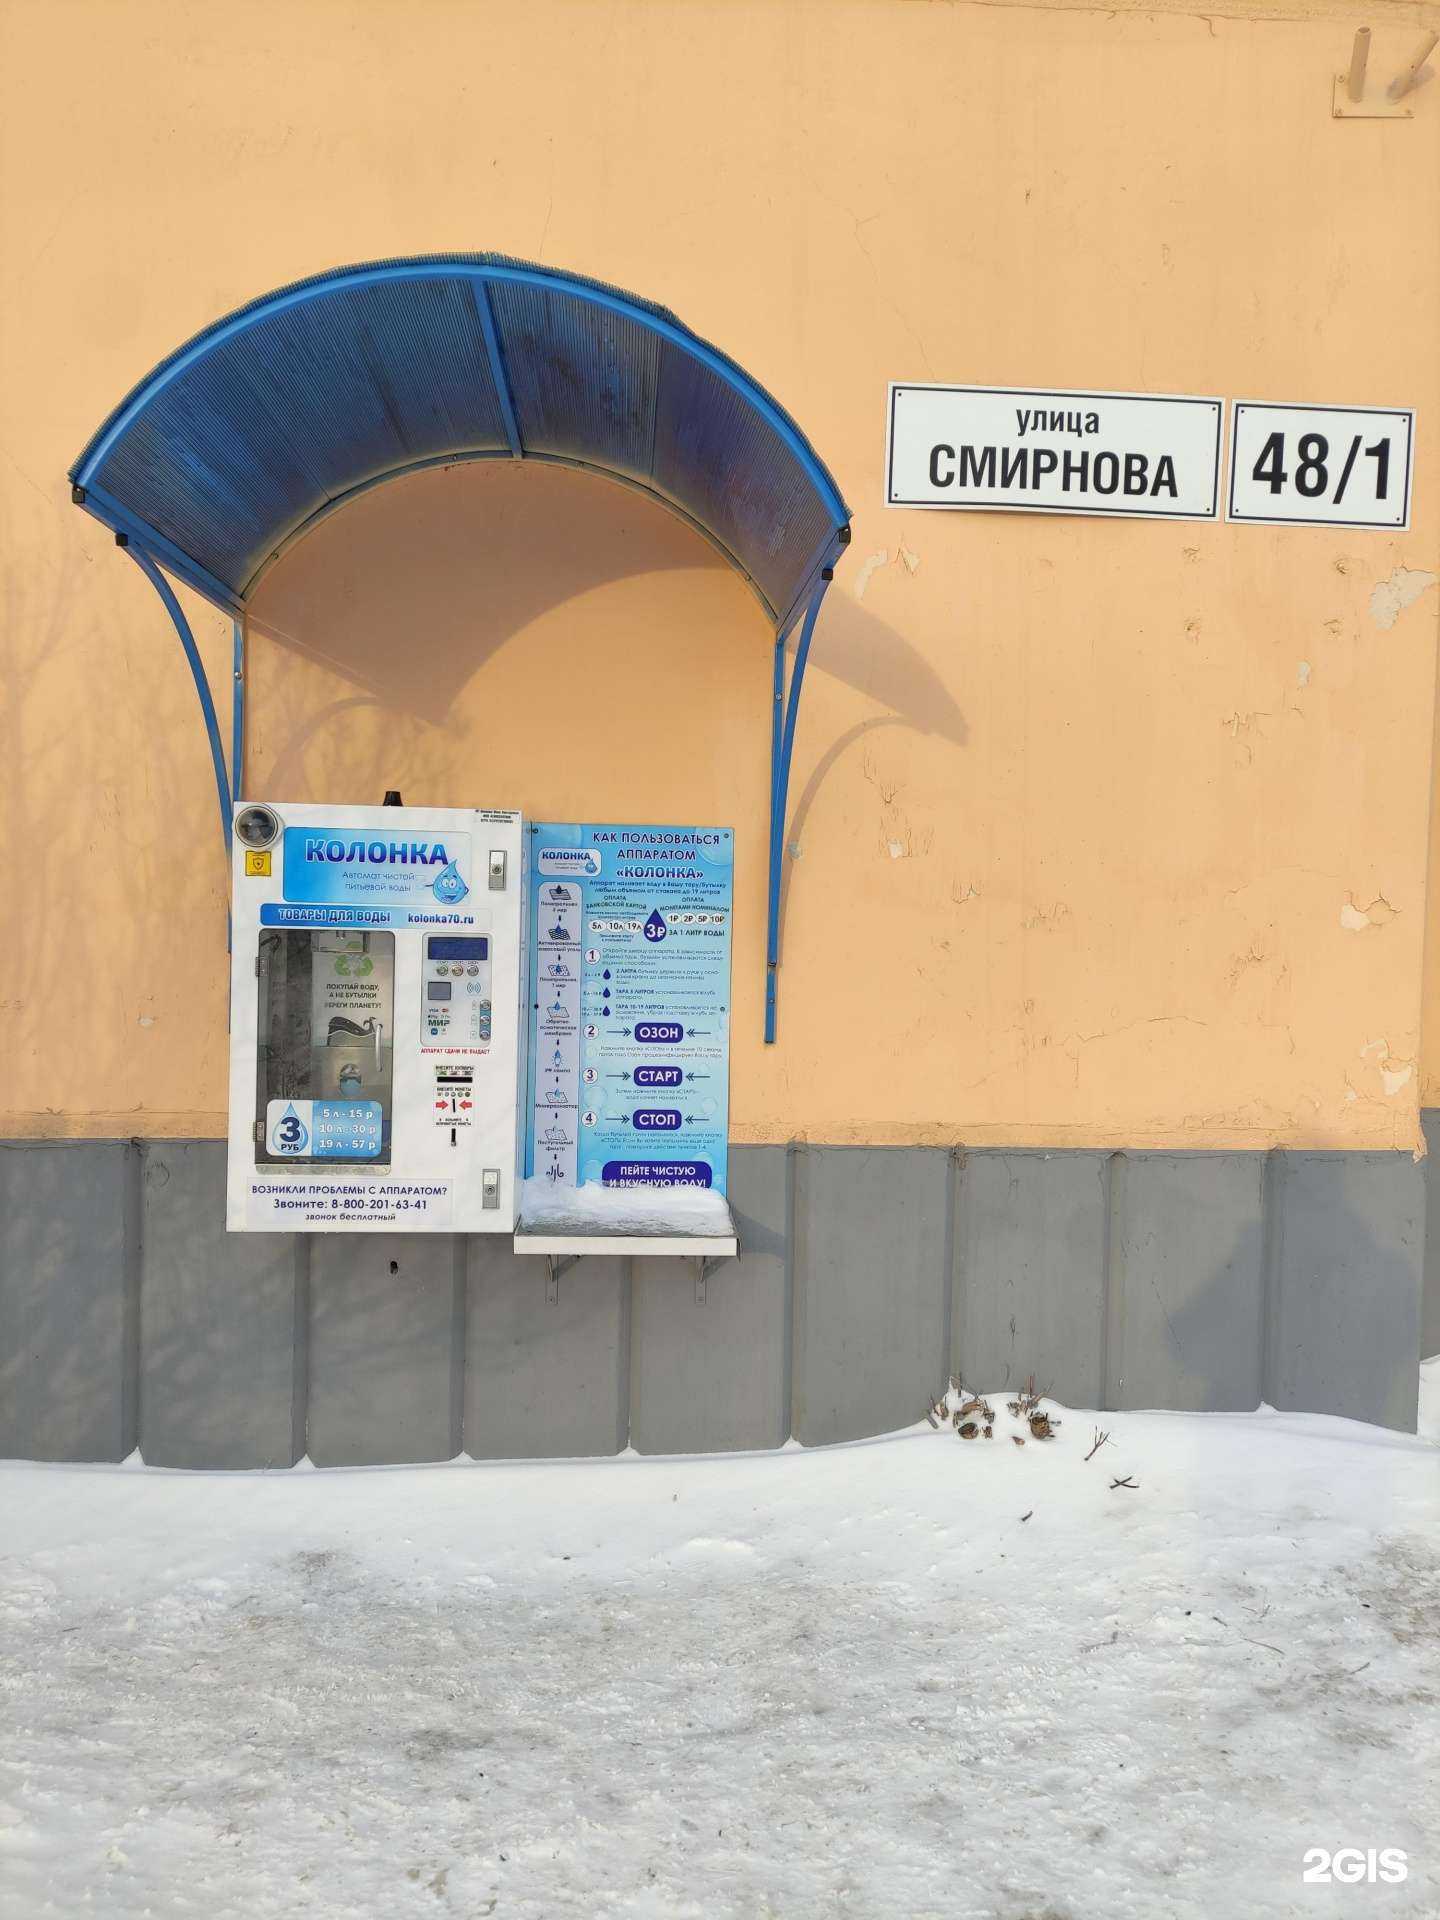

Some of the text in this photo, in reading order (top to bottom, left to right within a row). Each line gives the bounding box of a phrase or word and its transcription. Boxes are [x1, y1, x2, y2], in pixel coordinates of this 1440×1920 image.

[1016, 409, 1100, 438] улица
[929, 444, 1178, 498] СМИРНОВА
[1252, 432, 1391, 505] 48/1
[593, 832, 720, 845] КАК ПОЛЬЗОВАТЬСЯ
[306, 838, 449, 866] КОЛОНКА
[542, 851, 591, 861] КОЛОНКА
[617, 850, 696, 861] АППАРАТОМ
[342, 871, 416, 881] Автомат чистой
[616, 866, 704, 879] «КОЛОНКА»
[388, 884, 412, 892] воды
[279, 908, 391, 923] ТОВАРЫ ДЛЯ ВОДЫ
[408, 912, 475, 925] kolonka70.ru
[589, 950, 595, 960] 1
[428, 1019, 451, 1027] МИР
[588, 1025, 595, 1035] 2
[639, 1027, 679, 1039] ОЗОН
[586, 1069, 594, 1079] 3
[638, 1070, 679, 1082] СТАРТ
[323, 1109, 330, 1118] 5
[348, 1109, 362, 1118] 15
[365, 1111, 374, 1120] р
[585, 1112, 593, 1122] 4
[639, 1113, 676, 1126] СТОП
[279, 1116, 301, 1143] 3
[319, 1124, 333, 1133] 10
[352, 1124, 366, 1133] 30
[368, 1126, 377, 1135] р
[280, 1143, 300, 1152] РУБ
[319, 1139, 333, 1148] 19
[351, 1139, 365, 1148] 57
[368, 1141, 376, 1151] р
[620, 1165, 696, 1176] ПЕЙТЕ ЧИСТУЮ
[251, 1185, 448, 1196] ВОЗНИКЛИ ПРОБЛЕМЫ С АППАРАТОМ?
[273, 1199, 427, 1210] Звоните: 8-800-201-63-41
[305, 1212, 396, 1221] звонок бесплатный
